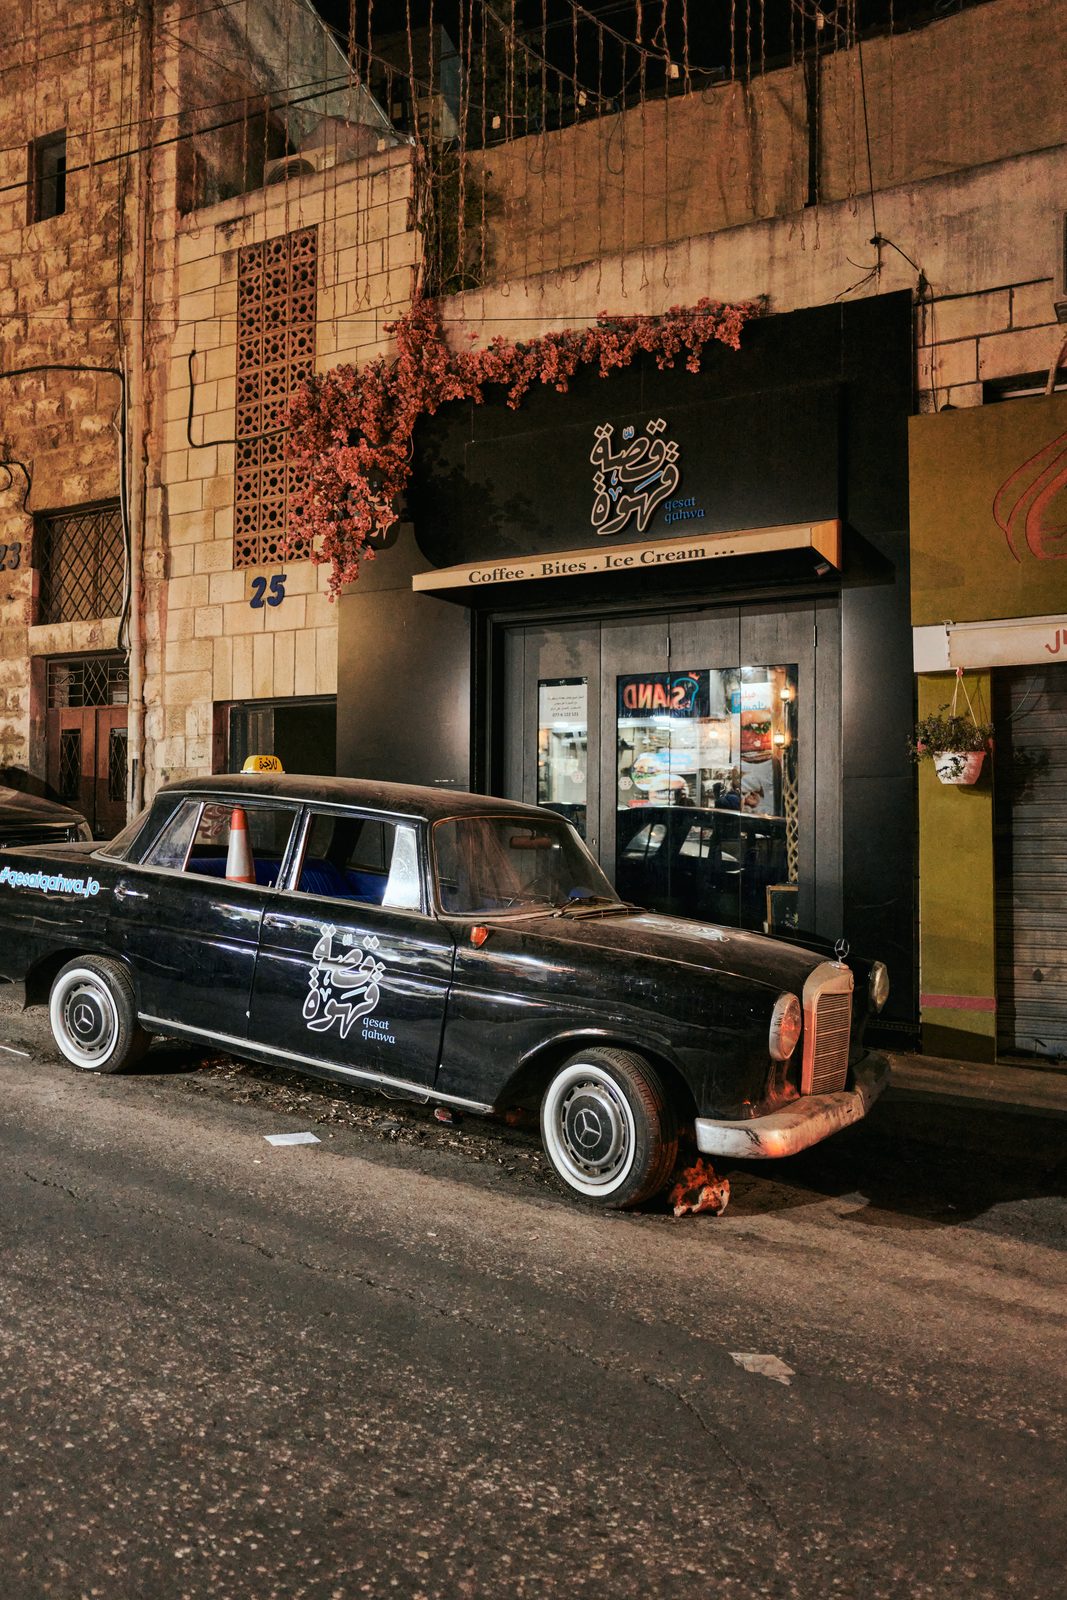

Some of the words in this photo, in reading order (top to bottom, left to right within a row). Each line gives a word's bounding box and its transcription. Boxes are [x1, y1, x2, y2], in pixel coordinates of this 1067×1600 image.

[664, 497, 696, 511] qesat
[664, 509, 705, 524] qahwa
[468, 567, 524, 583] Coffee
[541, 561, 587, 576] Bites
[605, 555, 634, 568] Ice
[640, 548, 706, 564] Cream
[250, 575, 287, 608] 25
[0, 866, 100, 898] #qesatqahwa.jo
[362, 1017, 390, 1030] qesat
[361, 1029, 396, 1044] qahwa
